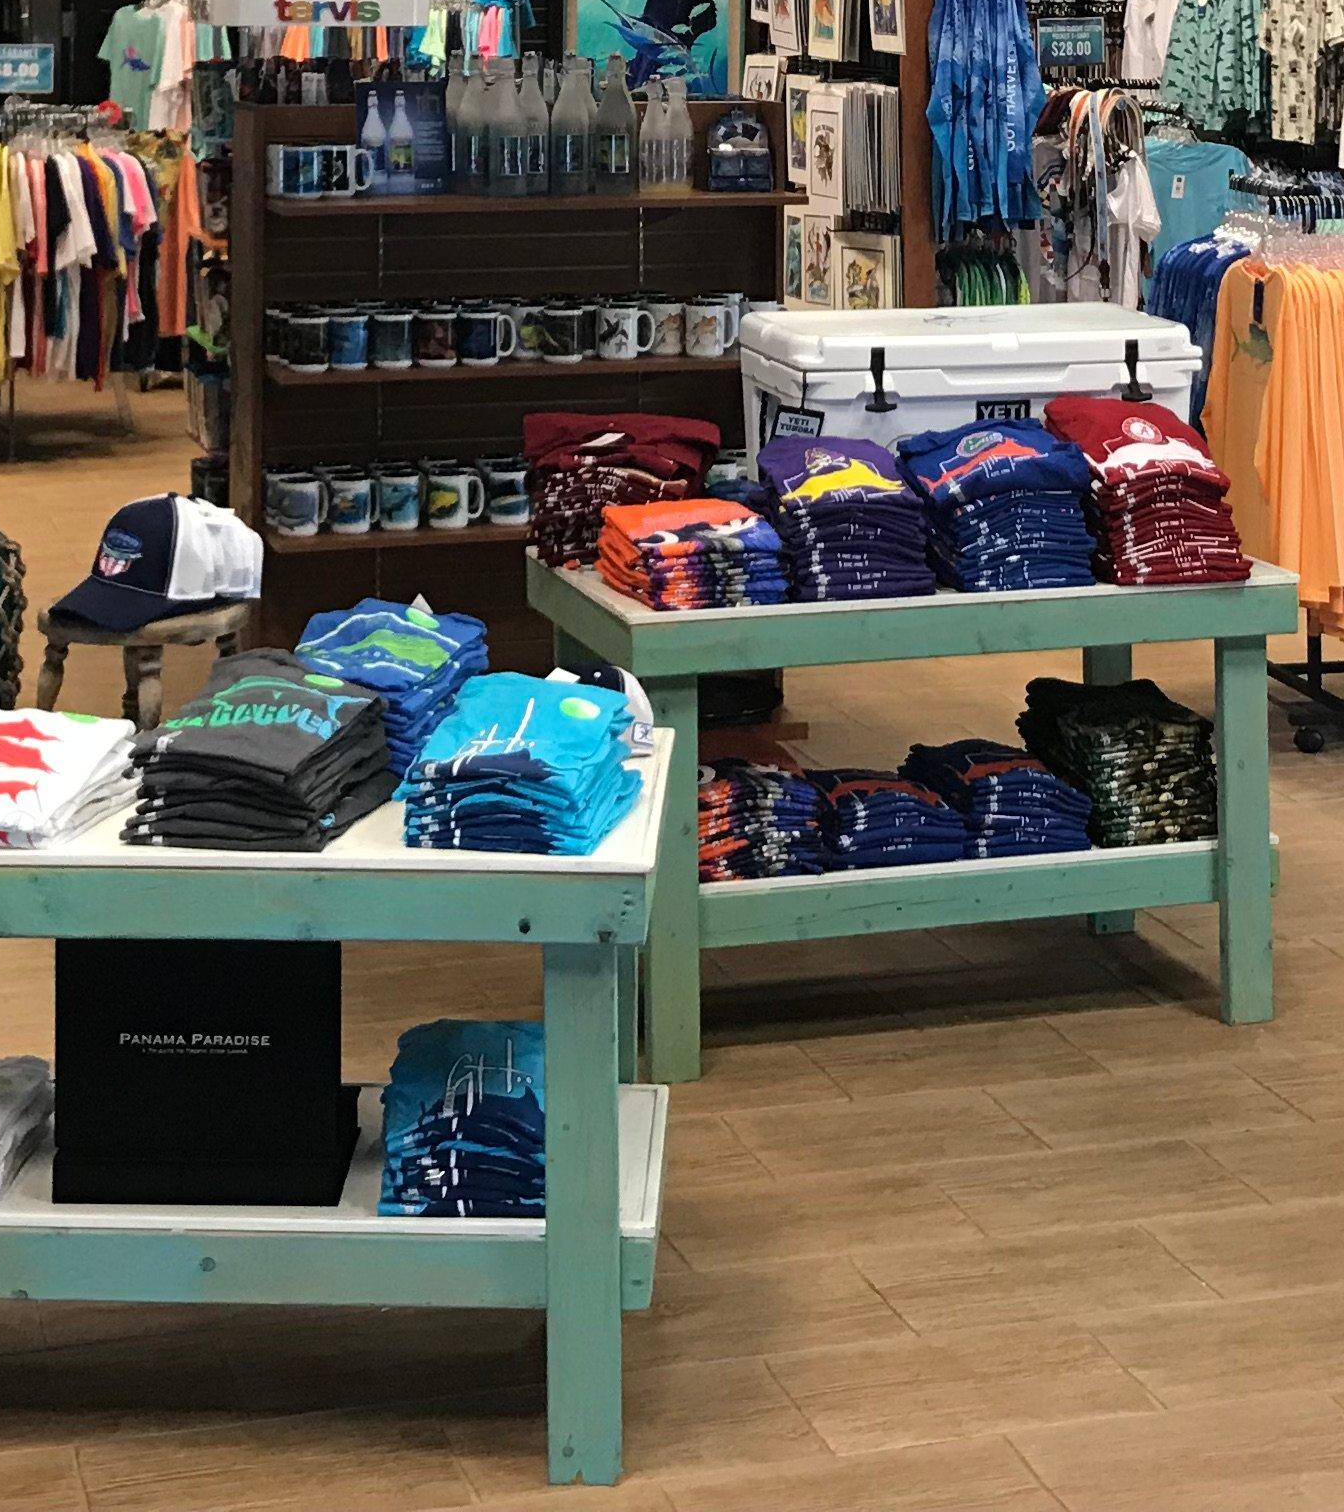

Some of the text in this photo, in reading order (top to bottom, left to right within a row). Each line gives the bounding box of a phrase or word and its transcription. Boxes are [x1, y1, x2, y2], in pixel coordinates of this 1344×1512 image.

[1051, 40, 1091, 57] $28.00
[980, 404, 1026, 420] YETI
[789, 416, 810, 427] YETI
[119, 1032, 271, 1046] PANAMA PARADISE
